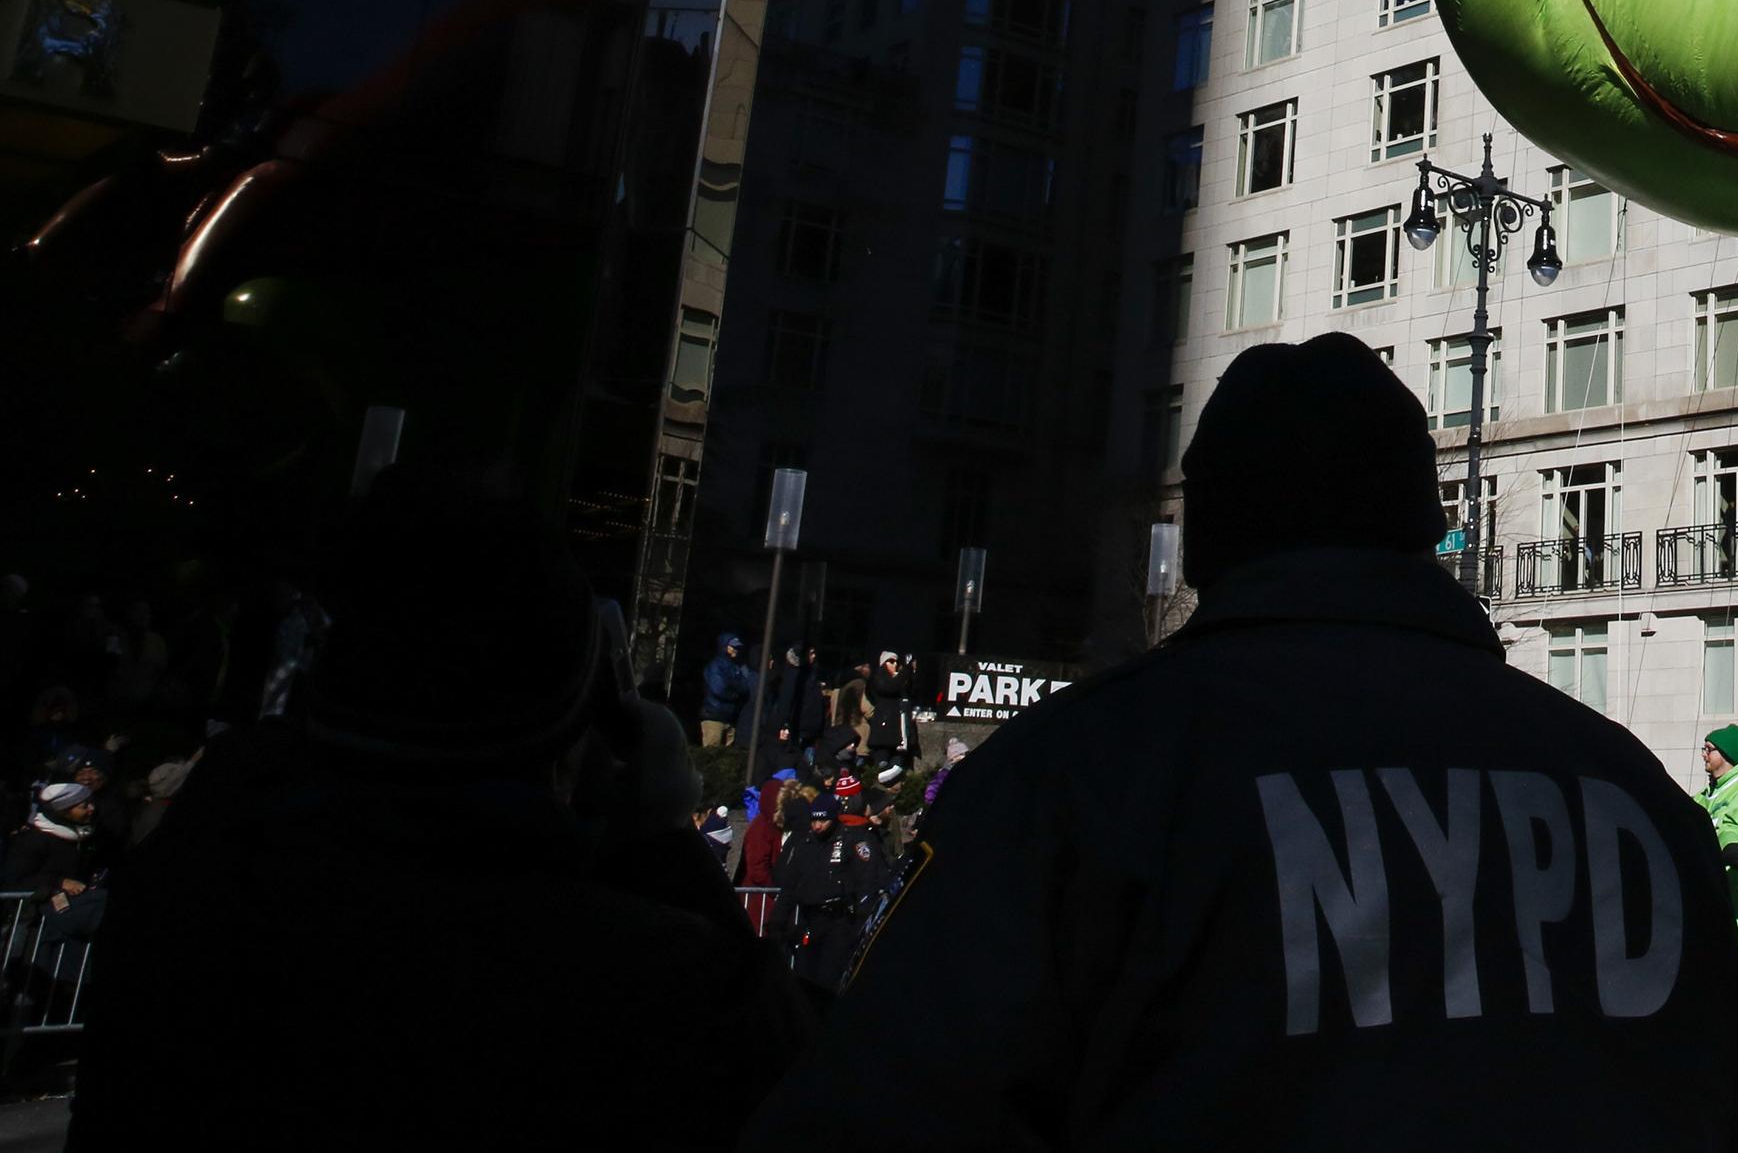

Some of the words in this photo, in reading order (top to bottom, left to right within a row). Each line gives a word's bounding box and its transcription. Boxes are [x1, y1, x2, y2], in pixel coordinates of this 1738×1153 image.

[1445, 533, 1455, 550] 61
[977, 661, 1024, 674] VALET
[947, 671, 1047, 707] PARK
[963, 707, 993, 719] ENTER
[995, 710, 1010, 720] ON
[1255, 766, 1684, 1037] NYPD
